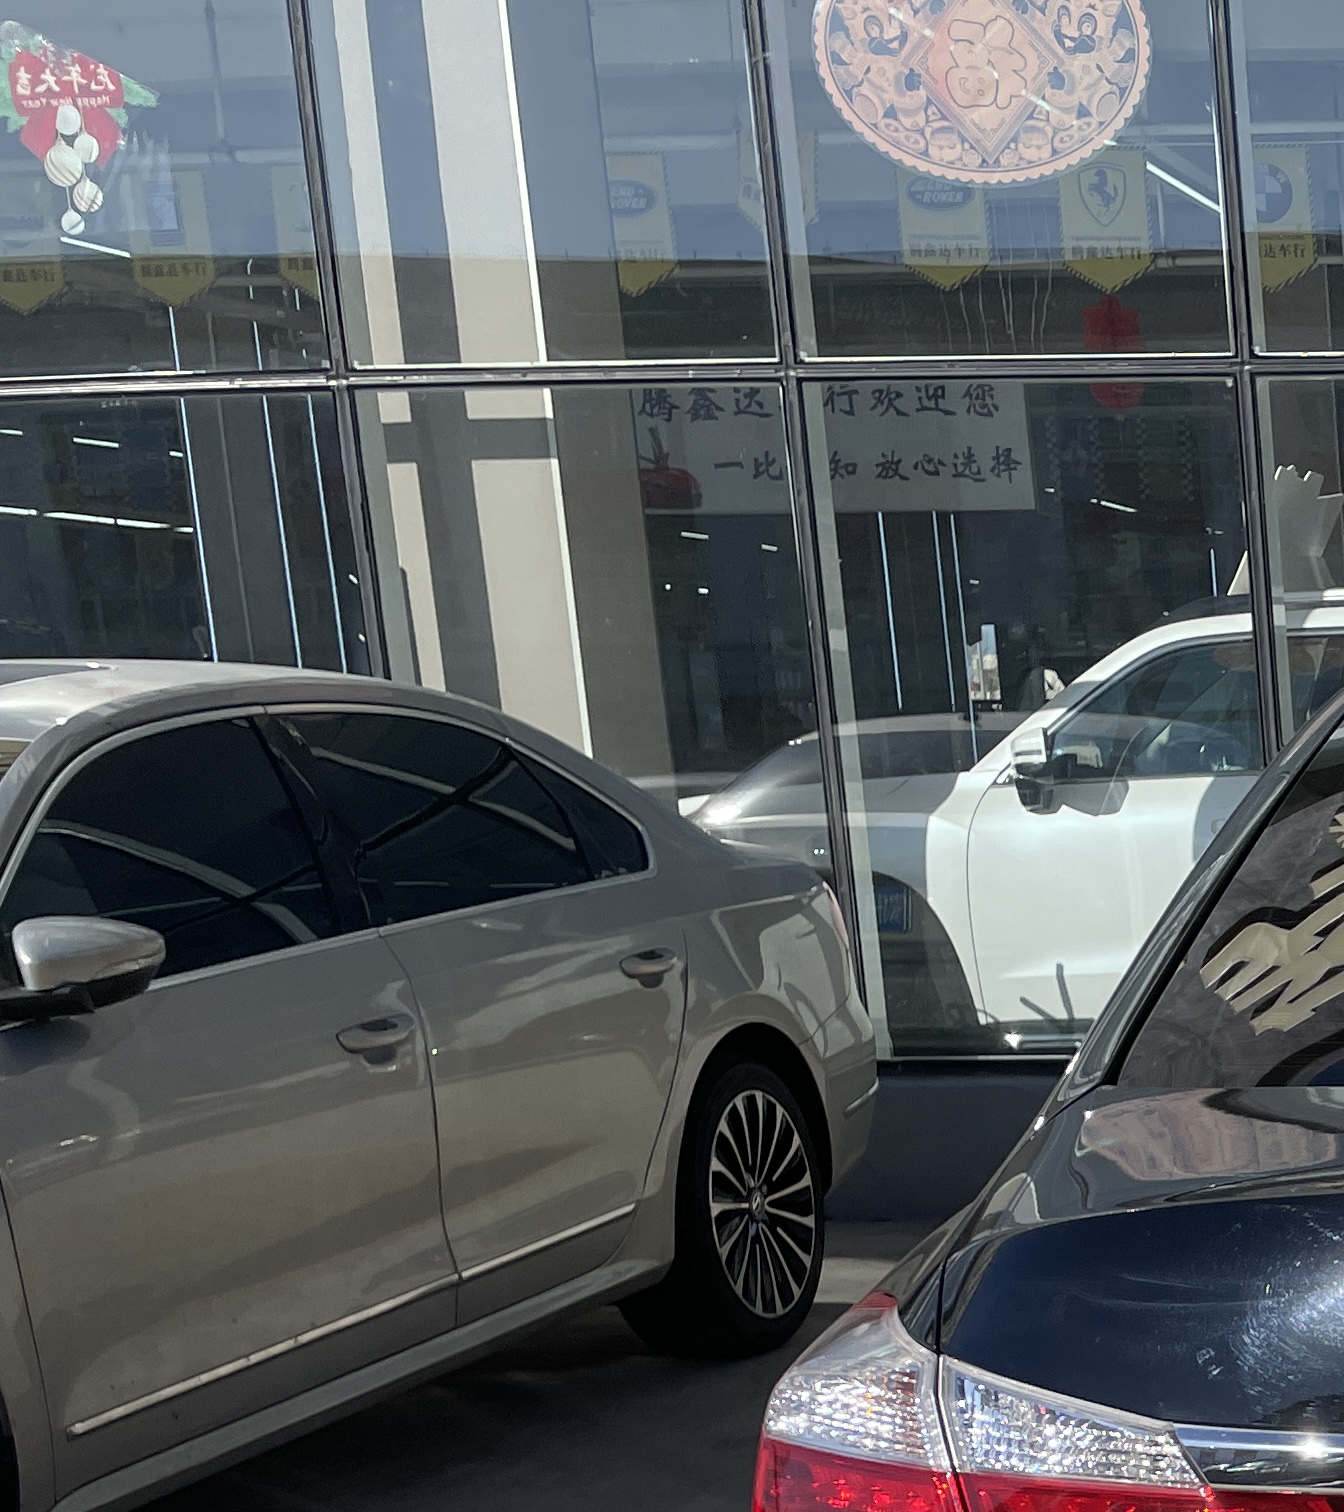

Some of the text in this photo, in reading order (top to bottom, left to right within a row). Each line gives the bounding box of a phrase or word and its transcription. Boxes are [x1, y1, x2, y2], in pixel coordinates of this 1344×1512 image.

[923, 190, 964, 203] ROVER
[637, 383, 1000, 423] 腾鑫达行欢迎您
